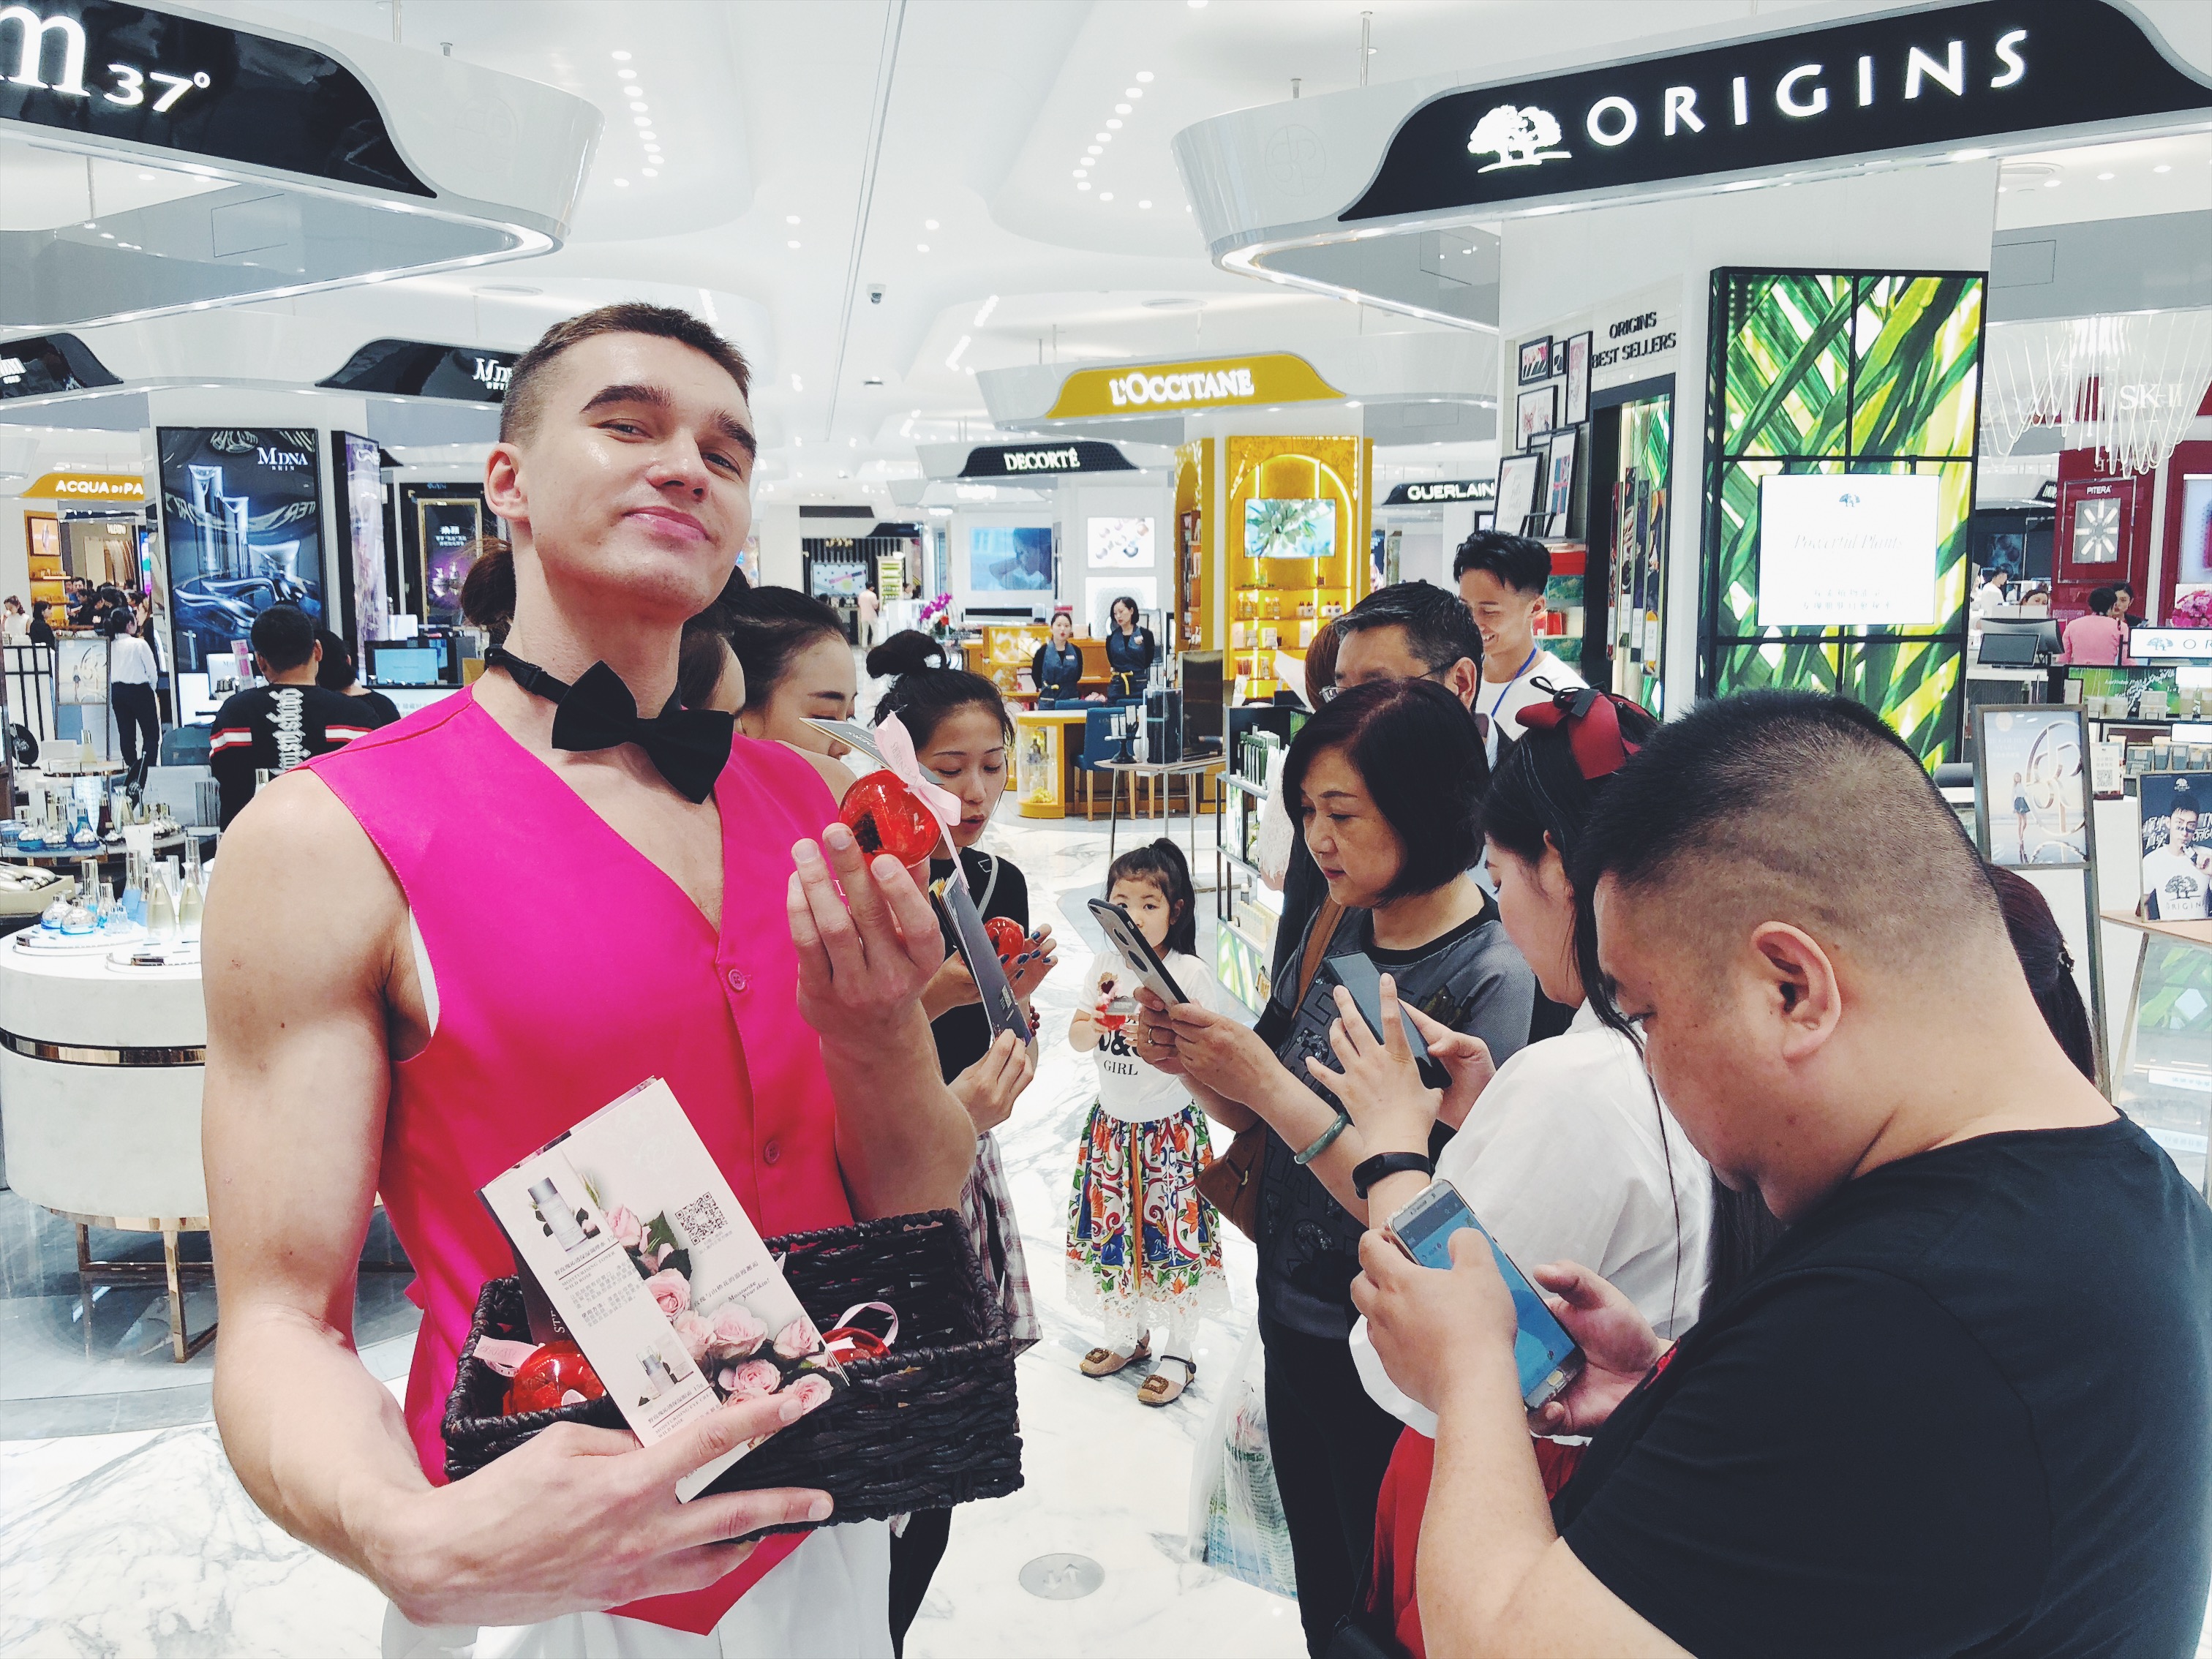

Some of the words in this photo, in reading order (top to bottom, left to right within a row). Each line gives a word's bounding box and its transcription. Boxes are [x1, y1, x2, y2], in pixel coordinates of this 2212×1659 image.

[1586, 29, 2028, 147] ORIGINS
[1609, 312, 1657, 339] ORIGINS
[1591, 347, 1620, 368] BEST
[1622, 333, 1677, 360] SELLERS
[1108, 369, 1255, 405] L'OCCITANE
[257, 447, 309, 465] MDNA
[1003, 447, 1081, 470] DECORTÉ
[55, 480, 110, 494] ACQUA
[111, 485, 123, 494] DI
[1407, 482, 1494, 500] GUERLAIN
[2086, 486, 2111, 494] PITERA
[1103, 1059, 1138, 1076] GIRL
